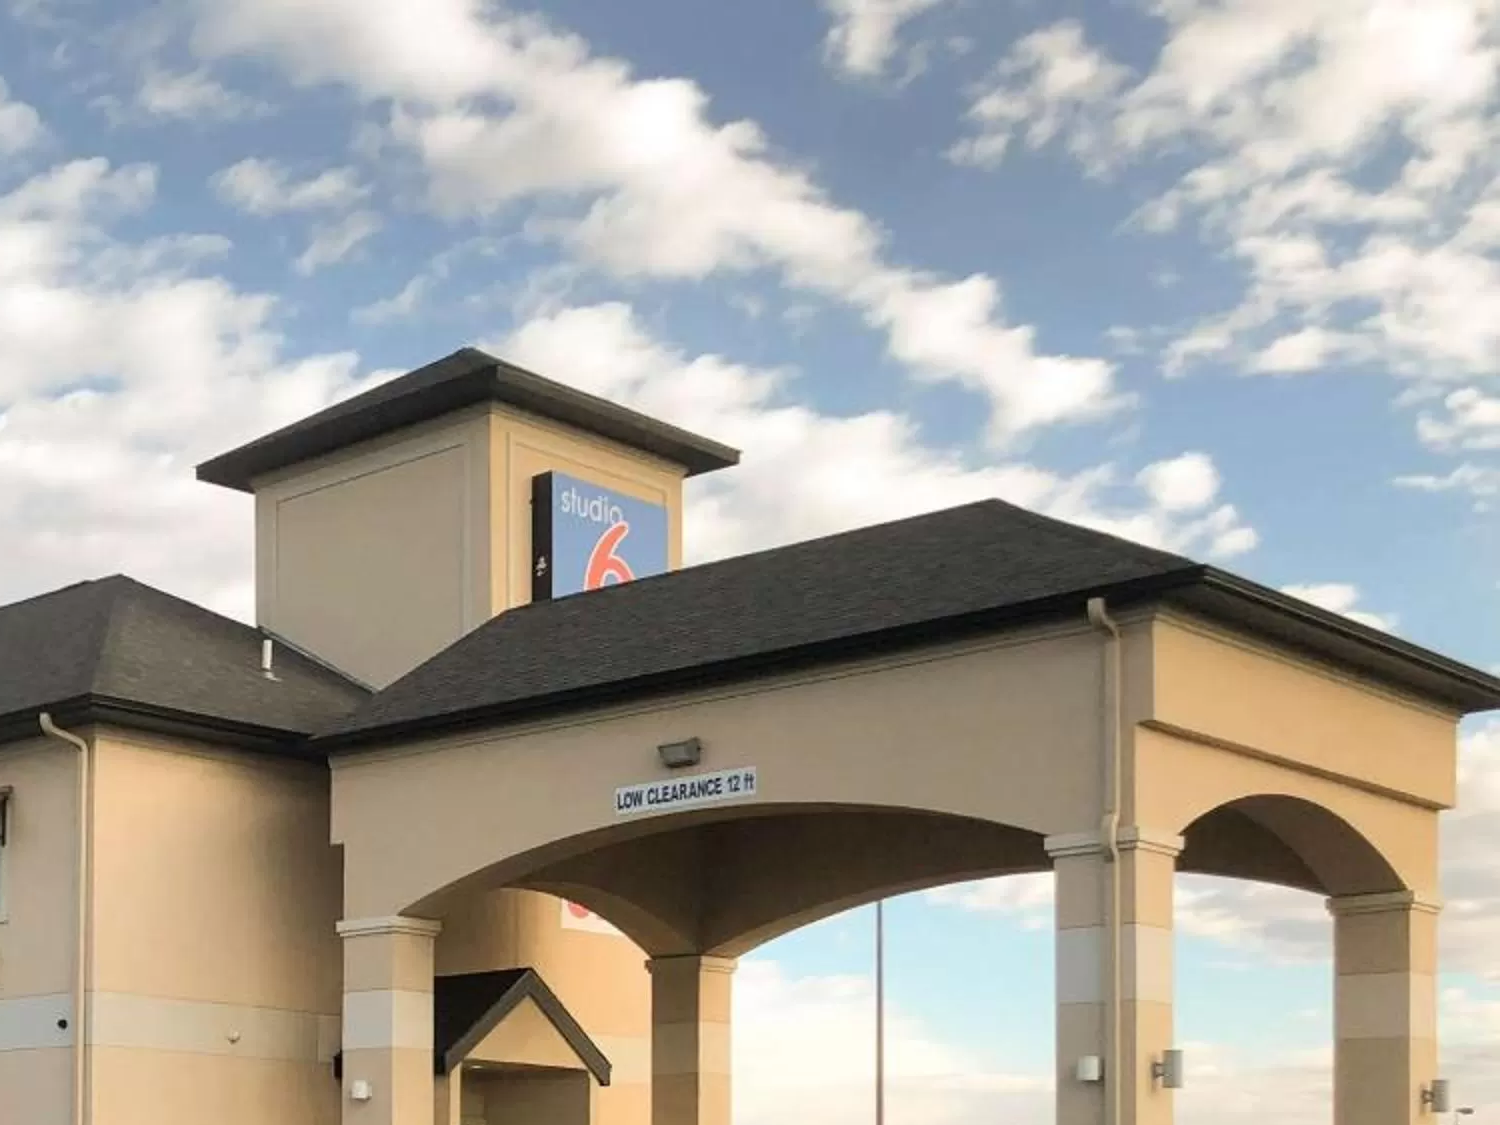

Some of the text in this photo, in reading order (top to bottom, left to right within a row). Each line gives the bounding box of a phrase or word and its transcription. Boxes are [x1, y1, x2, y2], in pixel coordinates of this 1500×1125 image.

[561, 487, 624, 525] studio
[583, 520, 636, 592] 6
[616, 772, 755, 810] LOW CLEARANCE 12 ft
